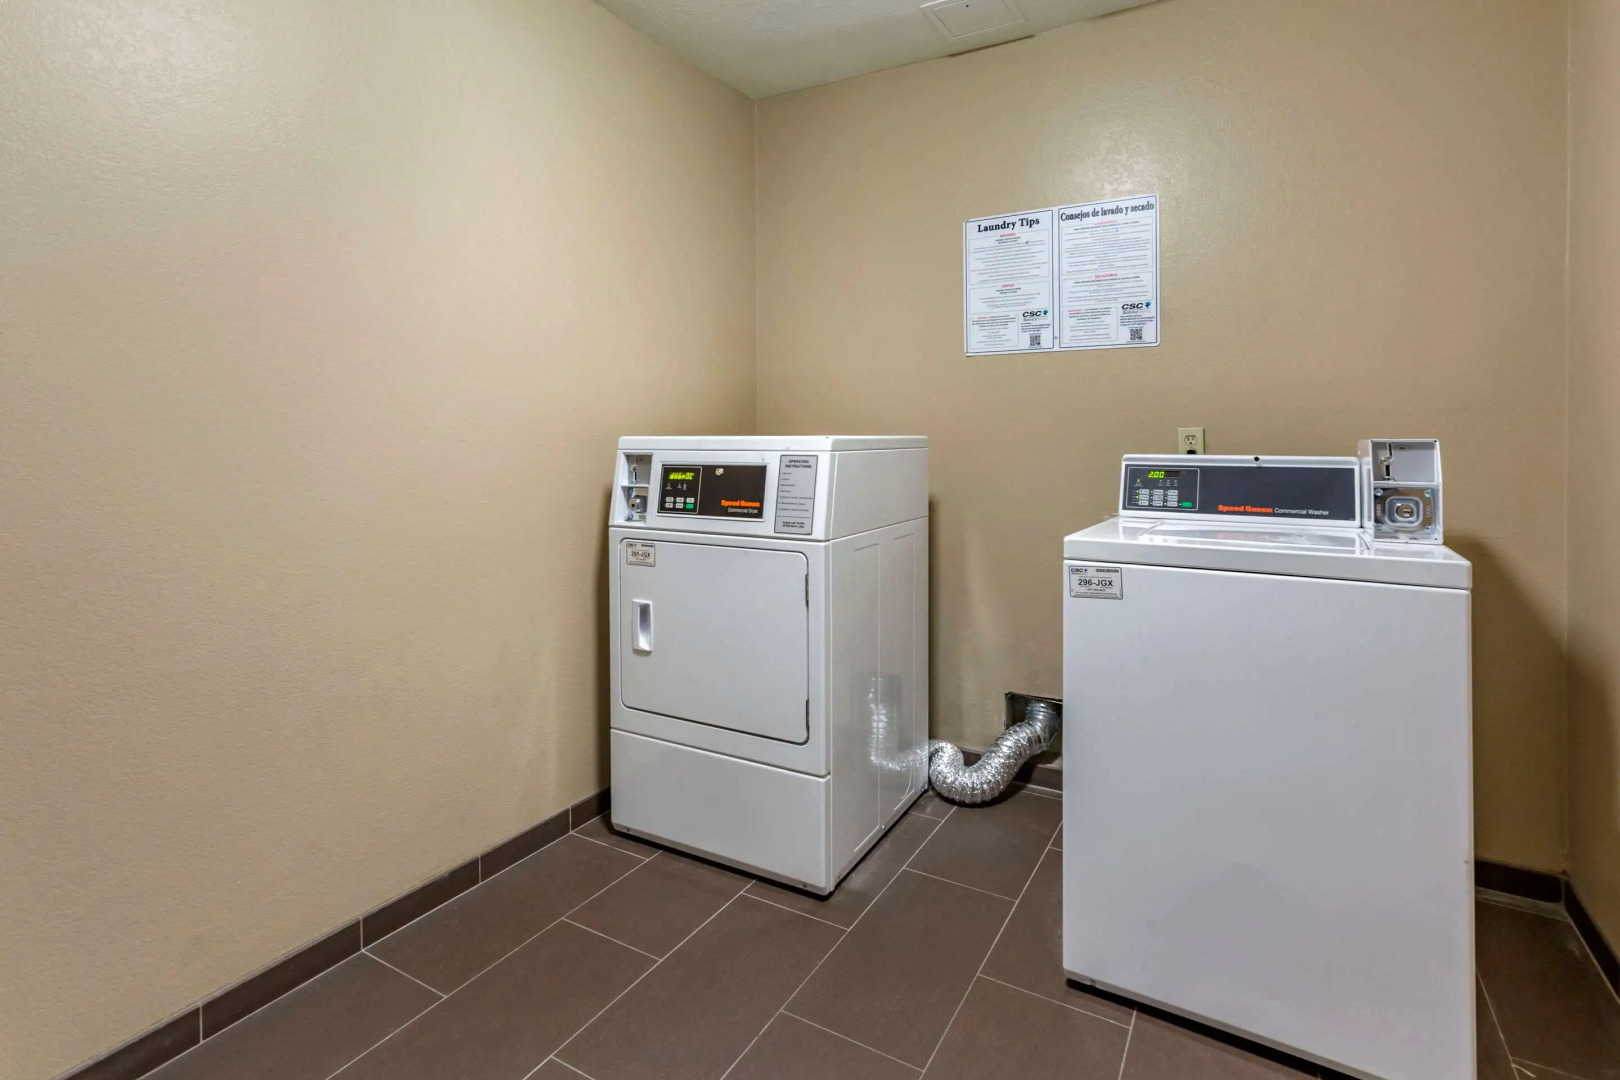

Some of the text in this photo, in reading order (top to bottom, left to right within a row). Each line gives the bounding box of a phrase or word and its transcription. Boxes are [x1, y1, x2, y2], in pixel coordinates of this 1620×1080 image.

[1060, 201, 1155, 221] Consejos de lavado y secado
[977, 217, 1040, 233] Laundry Tips
[1122, 302, 1144, 310] CSC
[1022, 310, 1042, 318] CSC
[721, 499, 740, 507] Speed
[1217, 504, 1330, 516] Speed Queen Commercial Washer
[1078, 578, 1114, 587] 296-JGX
